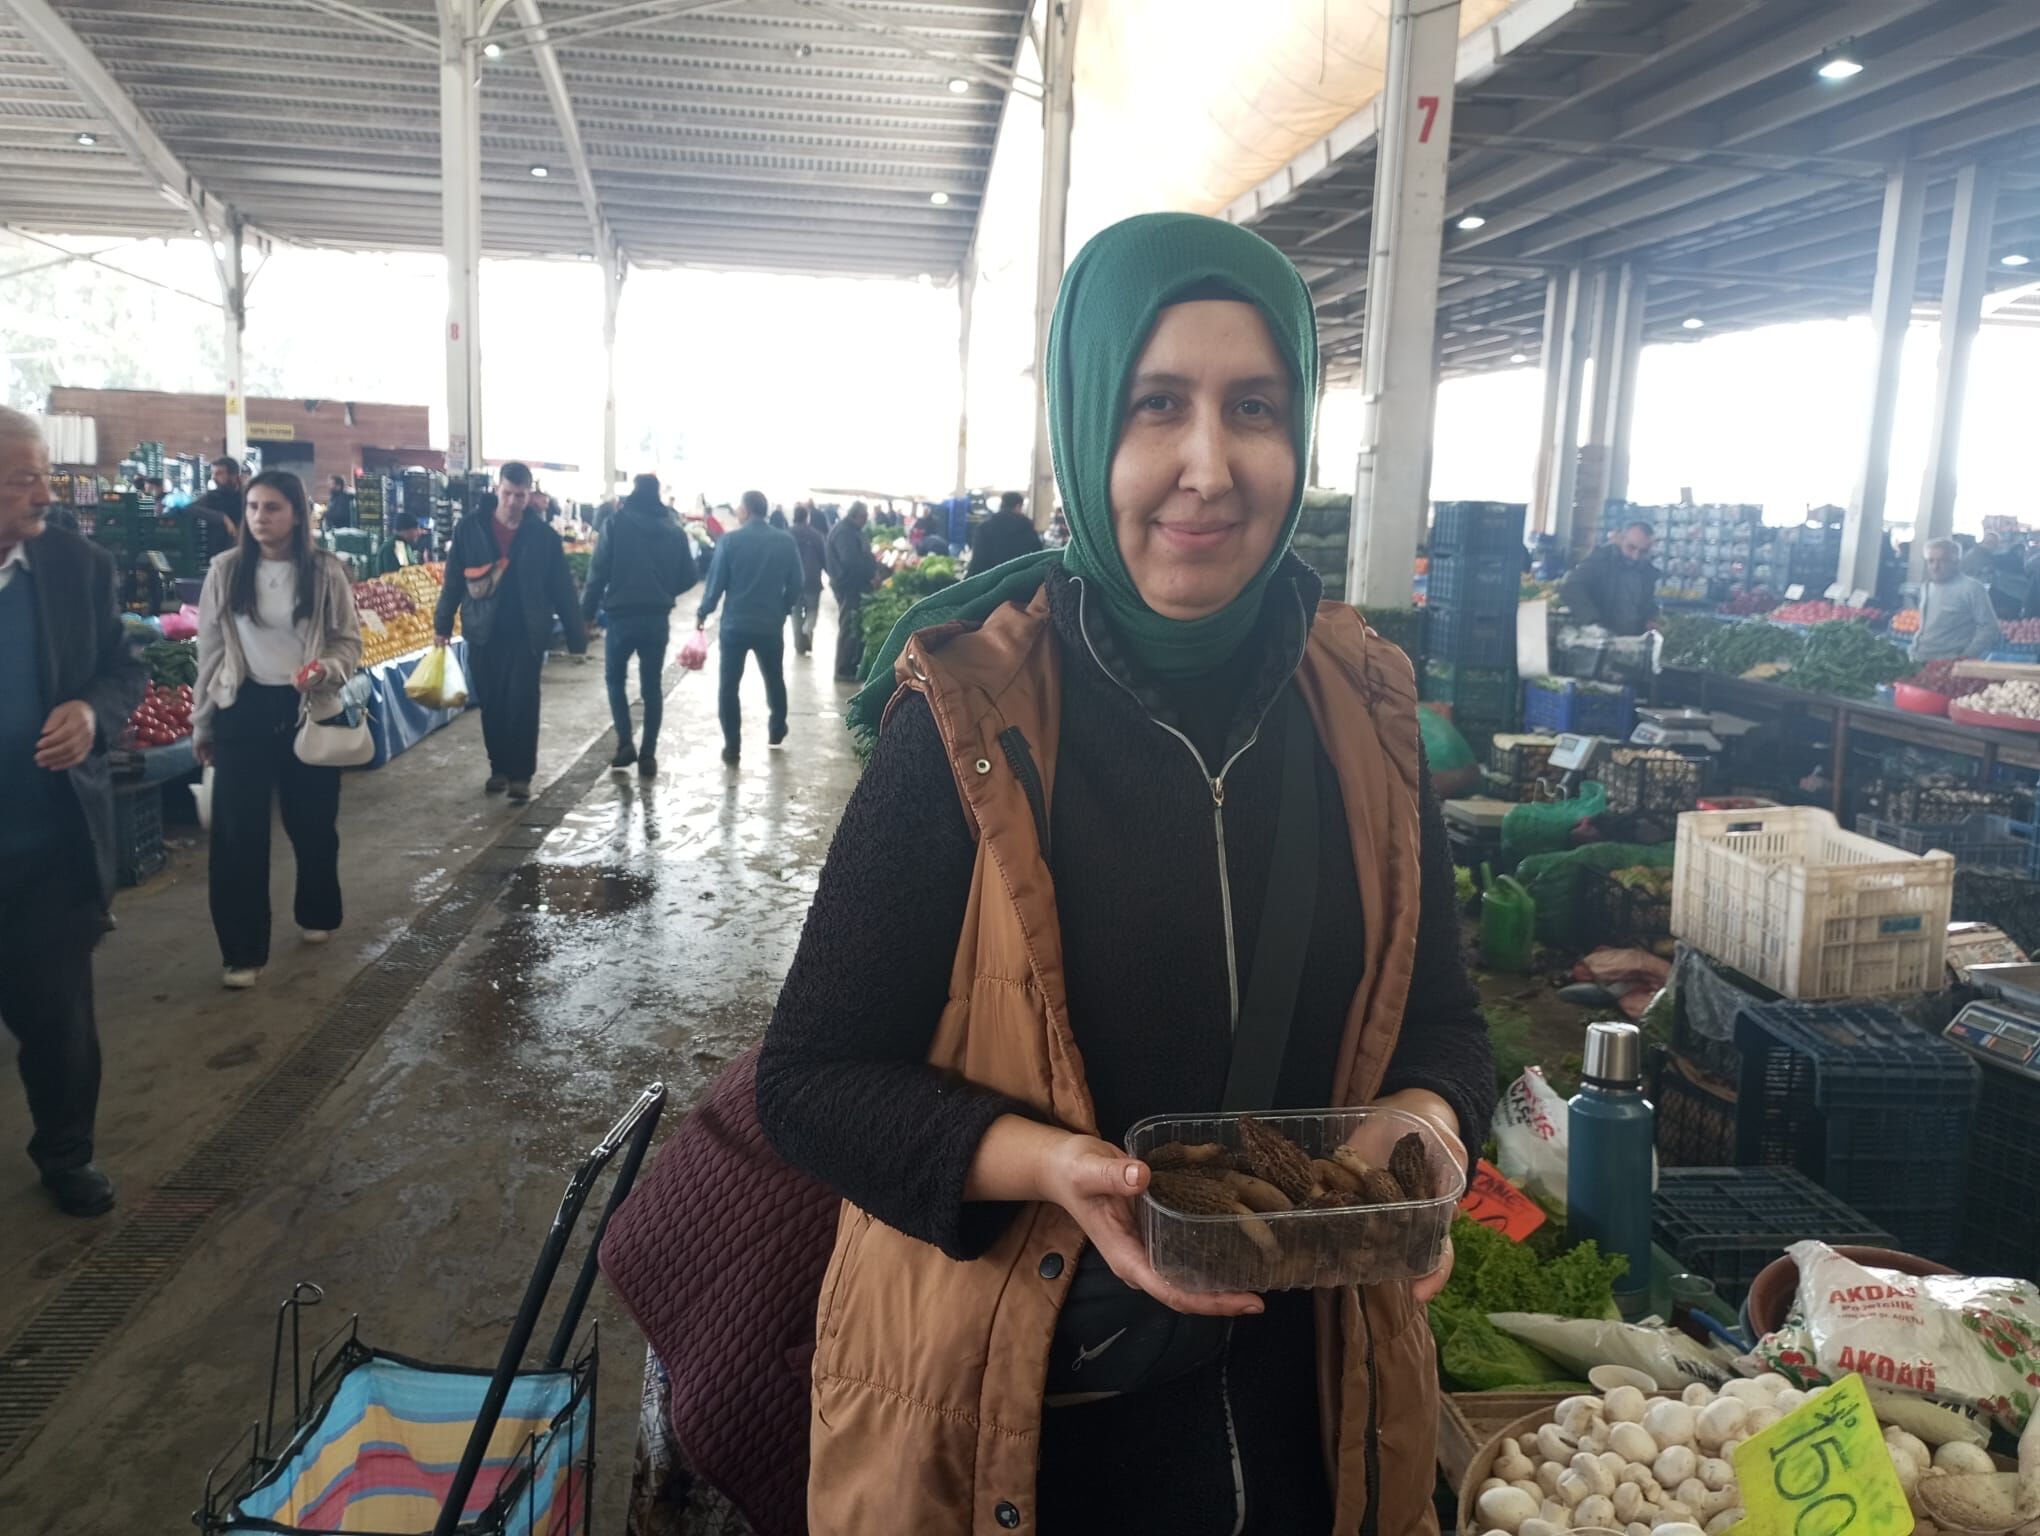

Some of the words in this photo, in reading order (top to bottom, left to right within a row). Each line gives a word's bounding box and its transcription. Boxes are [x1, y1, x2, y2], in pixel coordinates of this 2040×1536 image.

[1417, 96, 1439, 144] 7
[1837, 1346, 1936, 1393] AKDAĞ
[1768, 1412, 1857, 1536] 150
